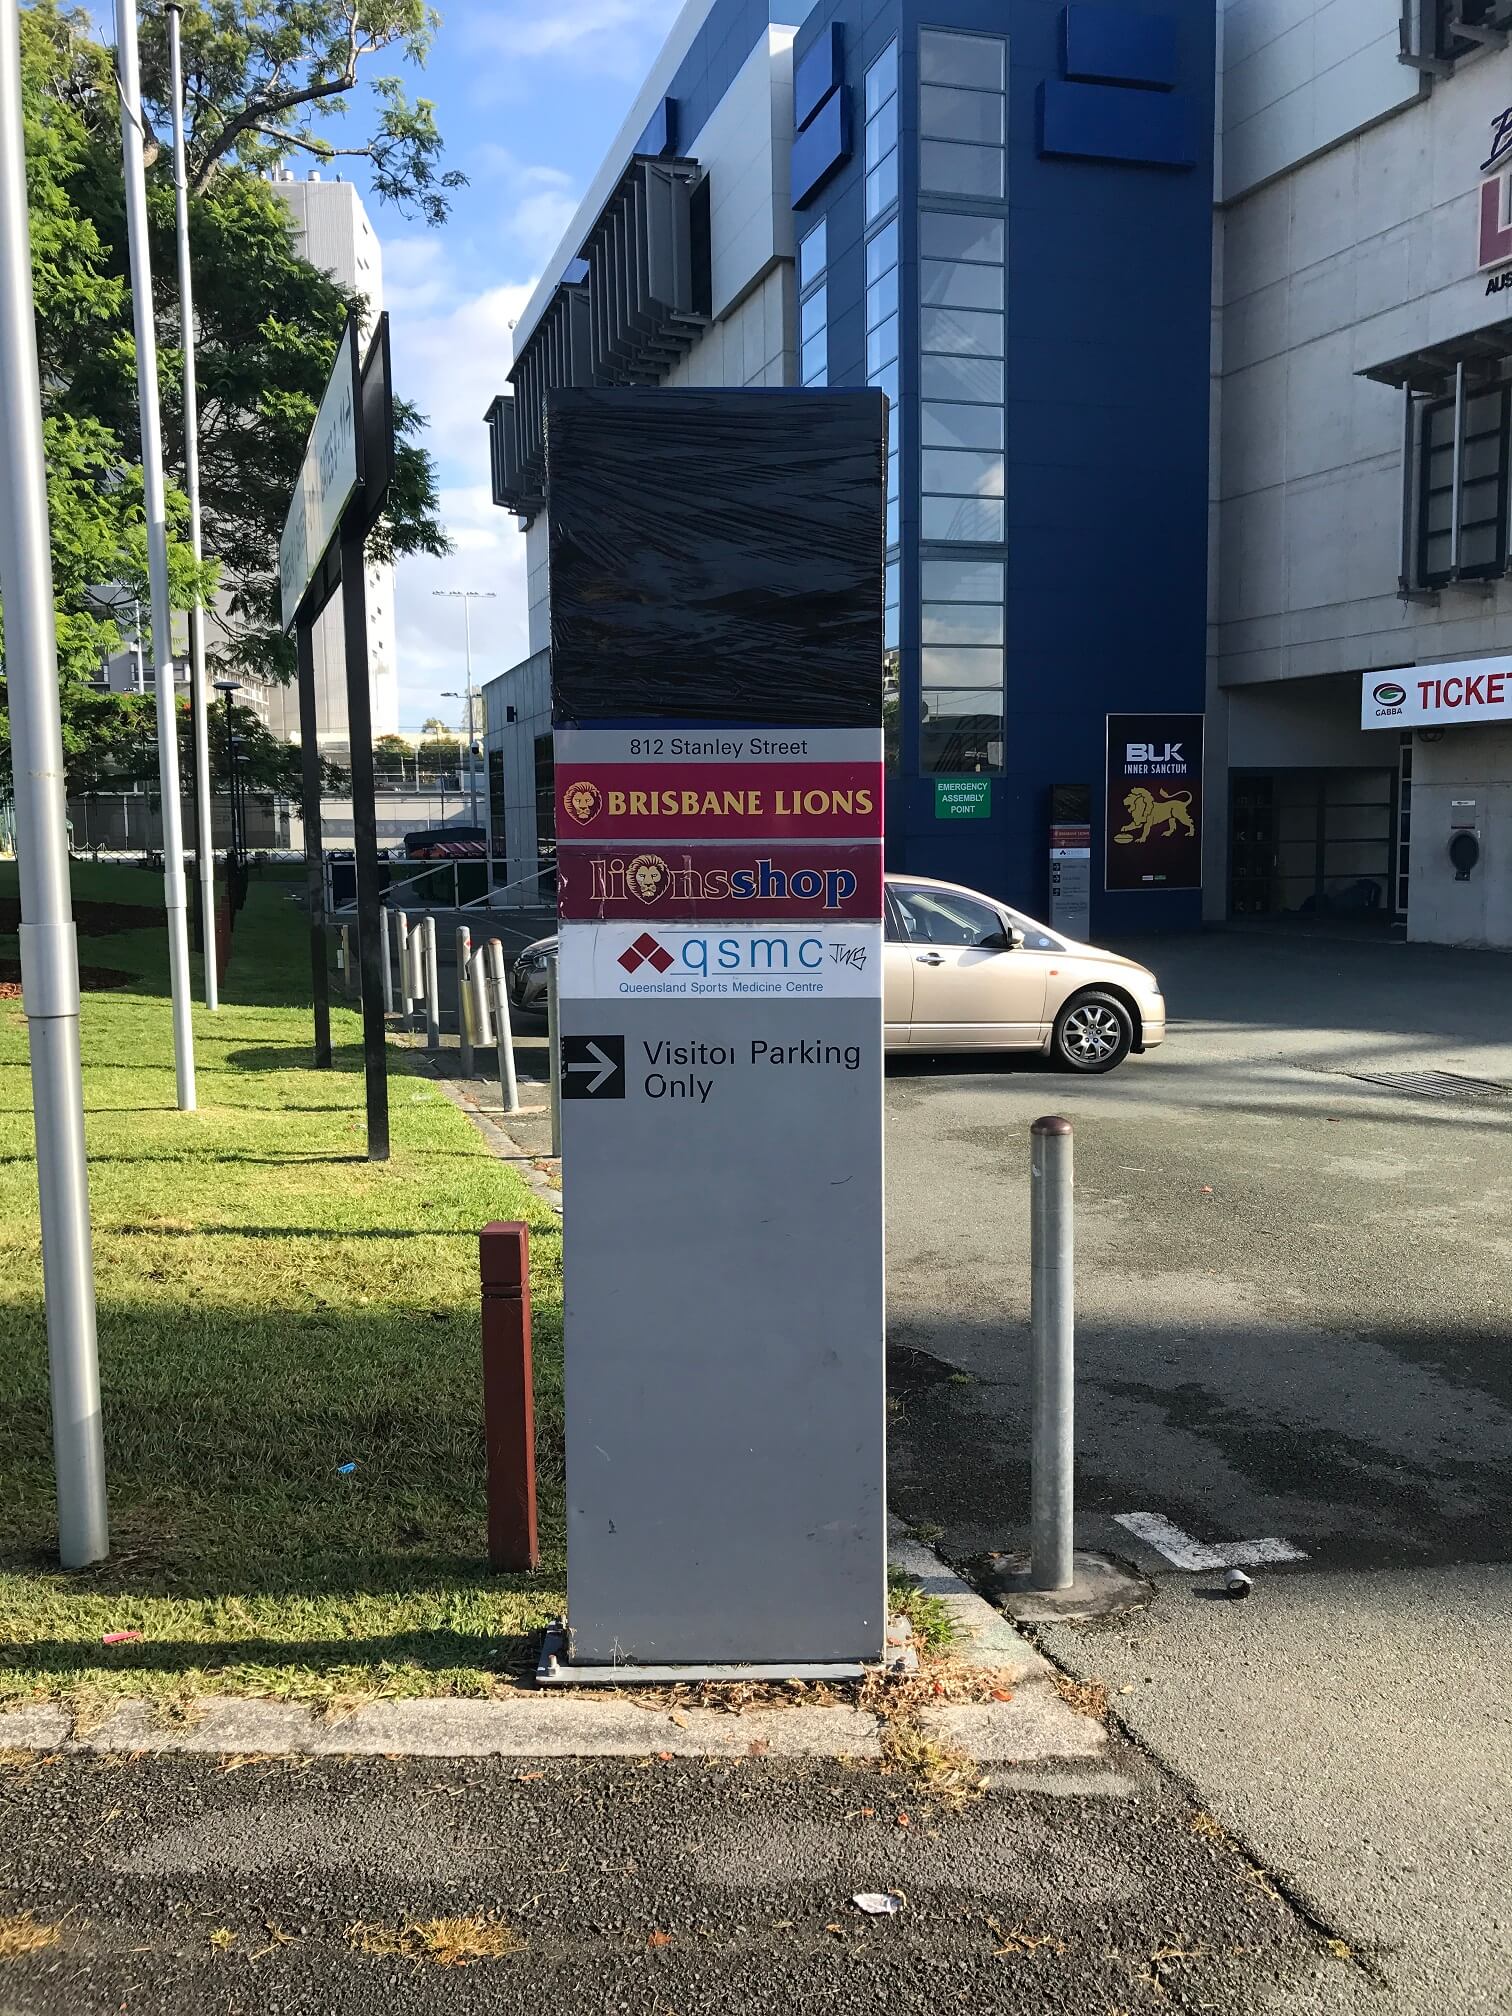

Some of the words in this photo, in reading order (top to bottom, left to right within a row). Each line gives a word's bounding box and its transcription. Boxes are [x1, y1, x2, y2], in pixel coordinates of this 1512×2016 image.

[1375, 708, 1403, 717] GABBA
[630, 739, 664, 755] 812
[671, 738, 743, 759] Stanley
[750, 738, 808, 755] Street
[1126, 743, 1184, 761] BLK
[1124, 764, 1148, 774] INNER
[1151, 763, 1187, 774] SANCTUM
[937, 782, 988, 791] EMERGENCY
[608, 790, 764, 815] BRISBANE
[775, 789, 874, 815] LIONS
[942, 794, 984, 802] ASSEMBLY
[950, 805, 975, 814] POINT
[682, 938, 823, 978] qsmc
[619, 982, 686, 993] Queensland
[691, 982, 728, 994] Sports
[732, 981, 782, 992] Medicine
[786, 981, 824, 992] Centre
[751, 1039, 861, 1070] Parking
[644, 1073, 714, 1103] Only
